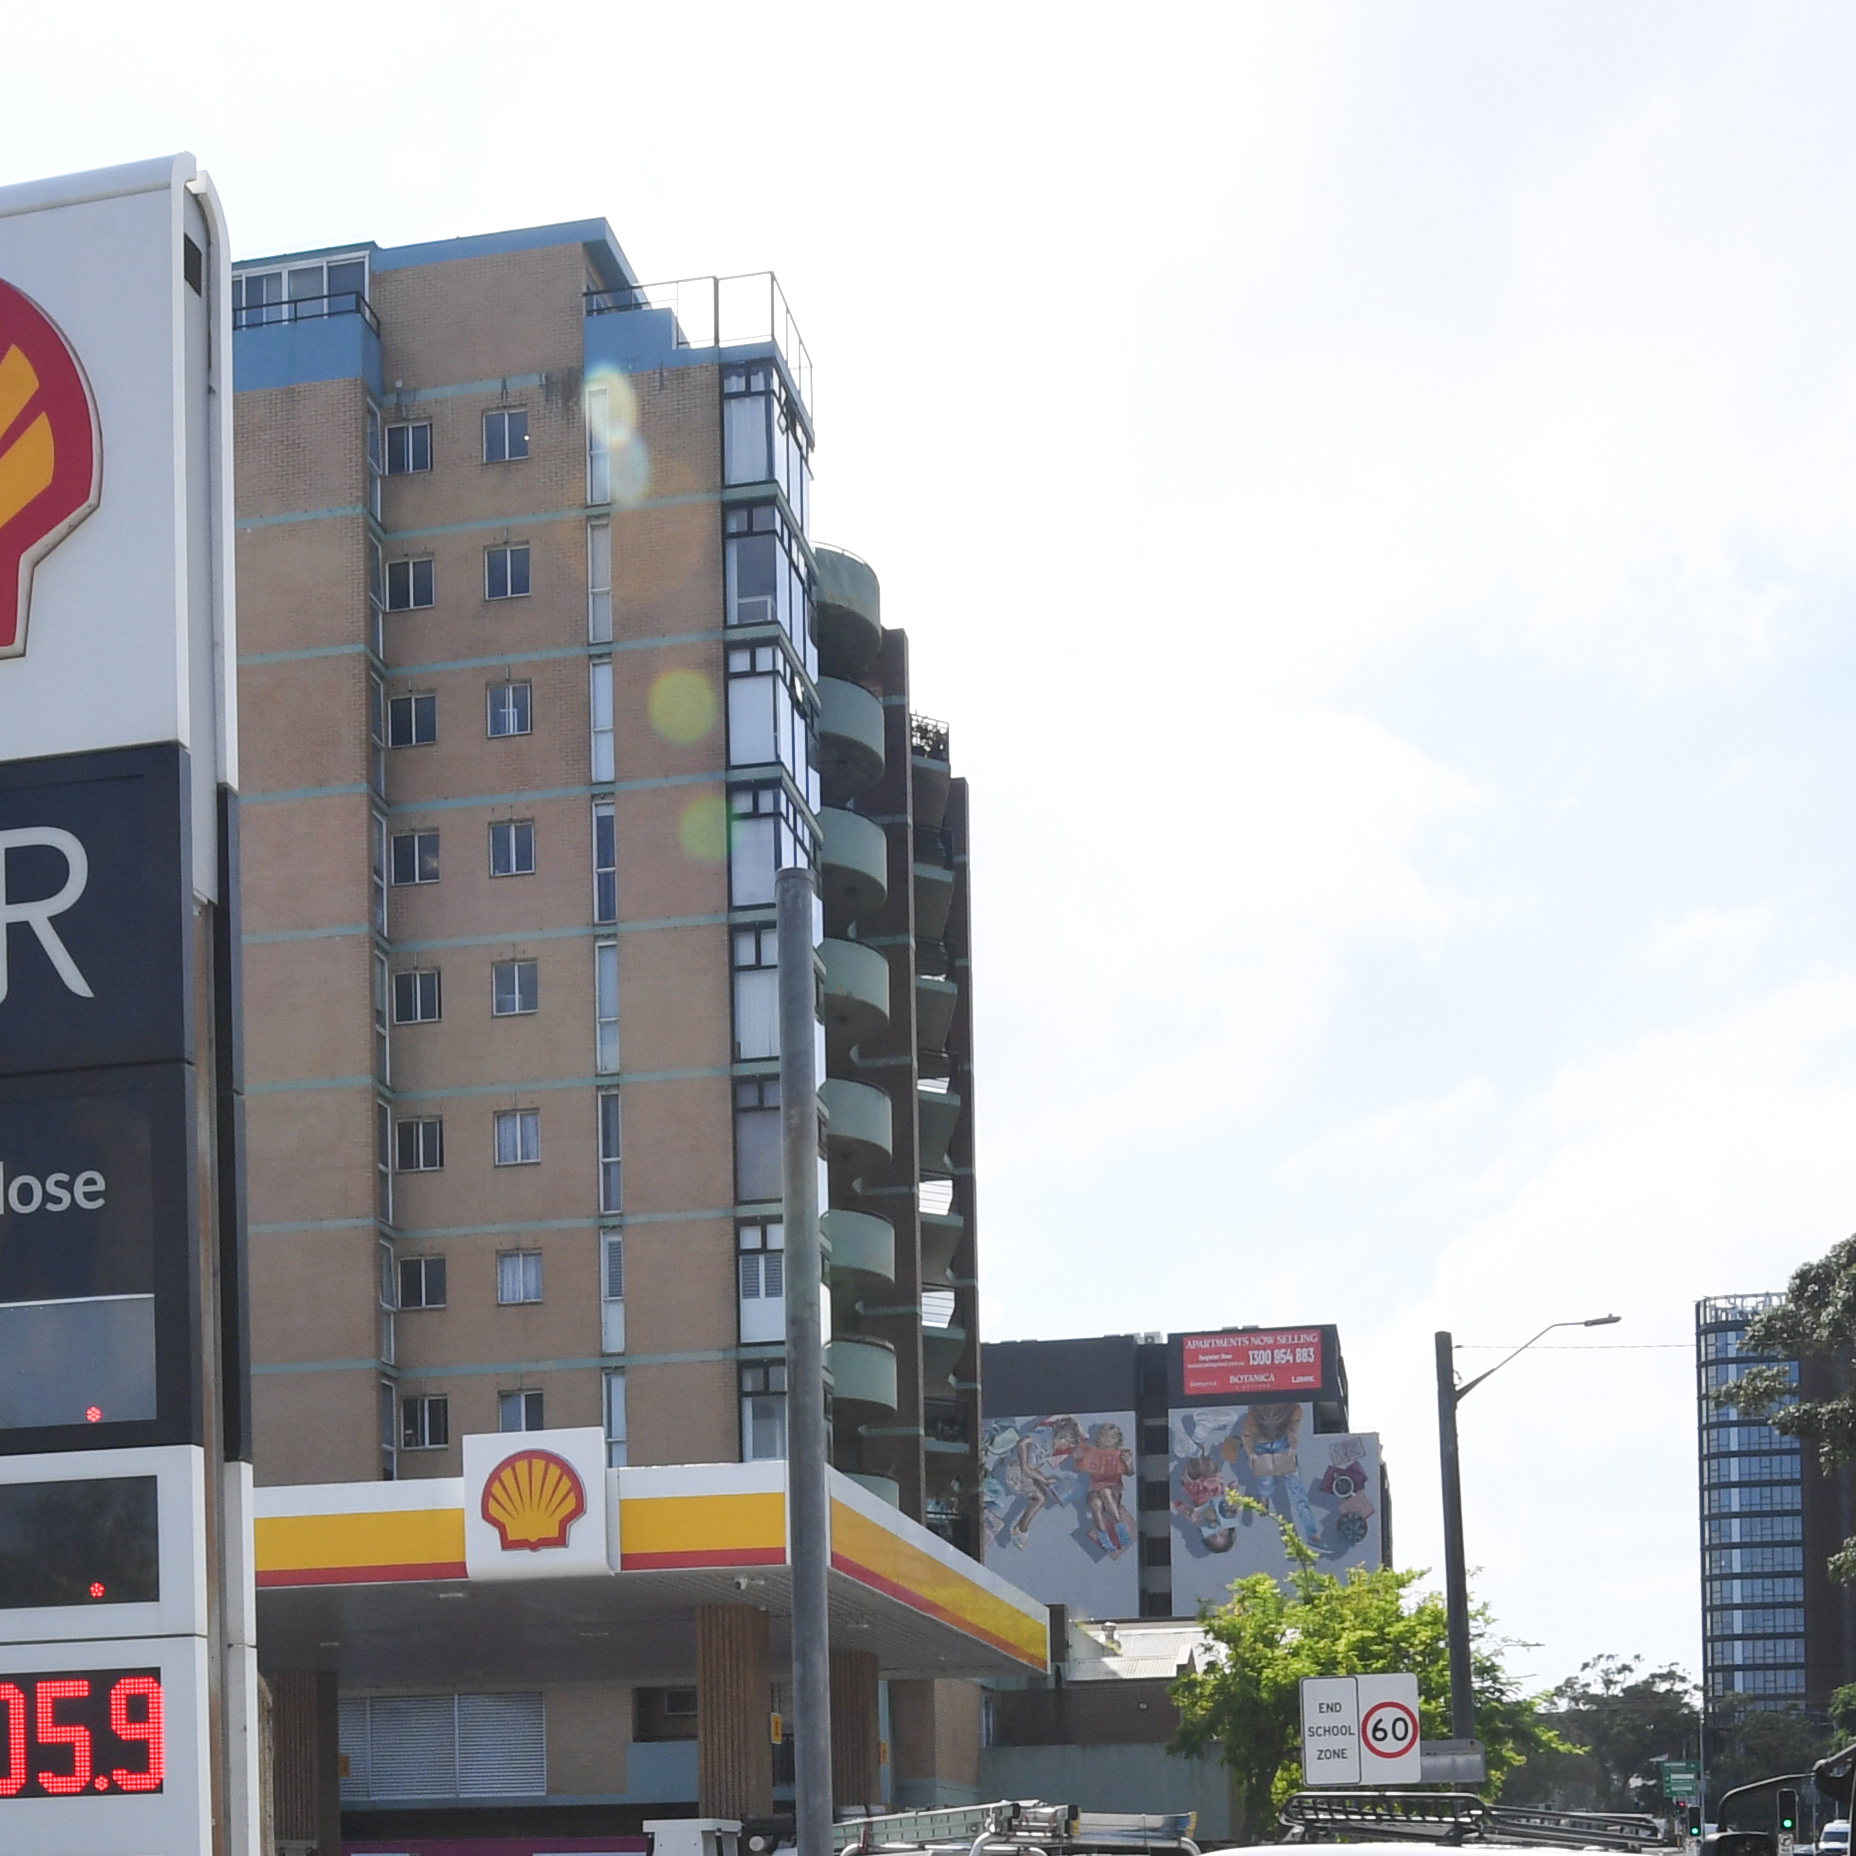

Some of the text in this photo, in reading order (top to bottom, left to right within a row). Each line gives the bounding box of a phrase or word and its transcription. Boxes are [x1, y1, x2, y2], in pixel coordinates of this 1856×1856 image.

[1186, 1334, 1317, 1350] APARTMENTS NOW SELLING
[1248, 1350, 1271, 1365] 1300
[1229, 1373, 1275, 1385] BOTANICA
[1318, 1702, 1342, 1714] END
[1308, 1725, 1355, 1737] SCHOOL
[1371, 1716, 1409, 1742] 60
[1317, 1749, 1347, 1760] ZONE
